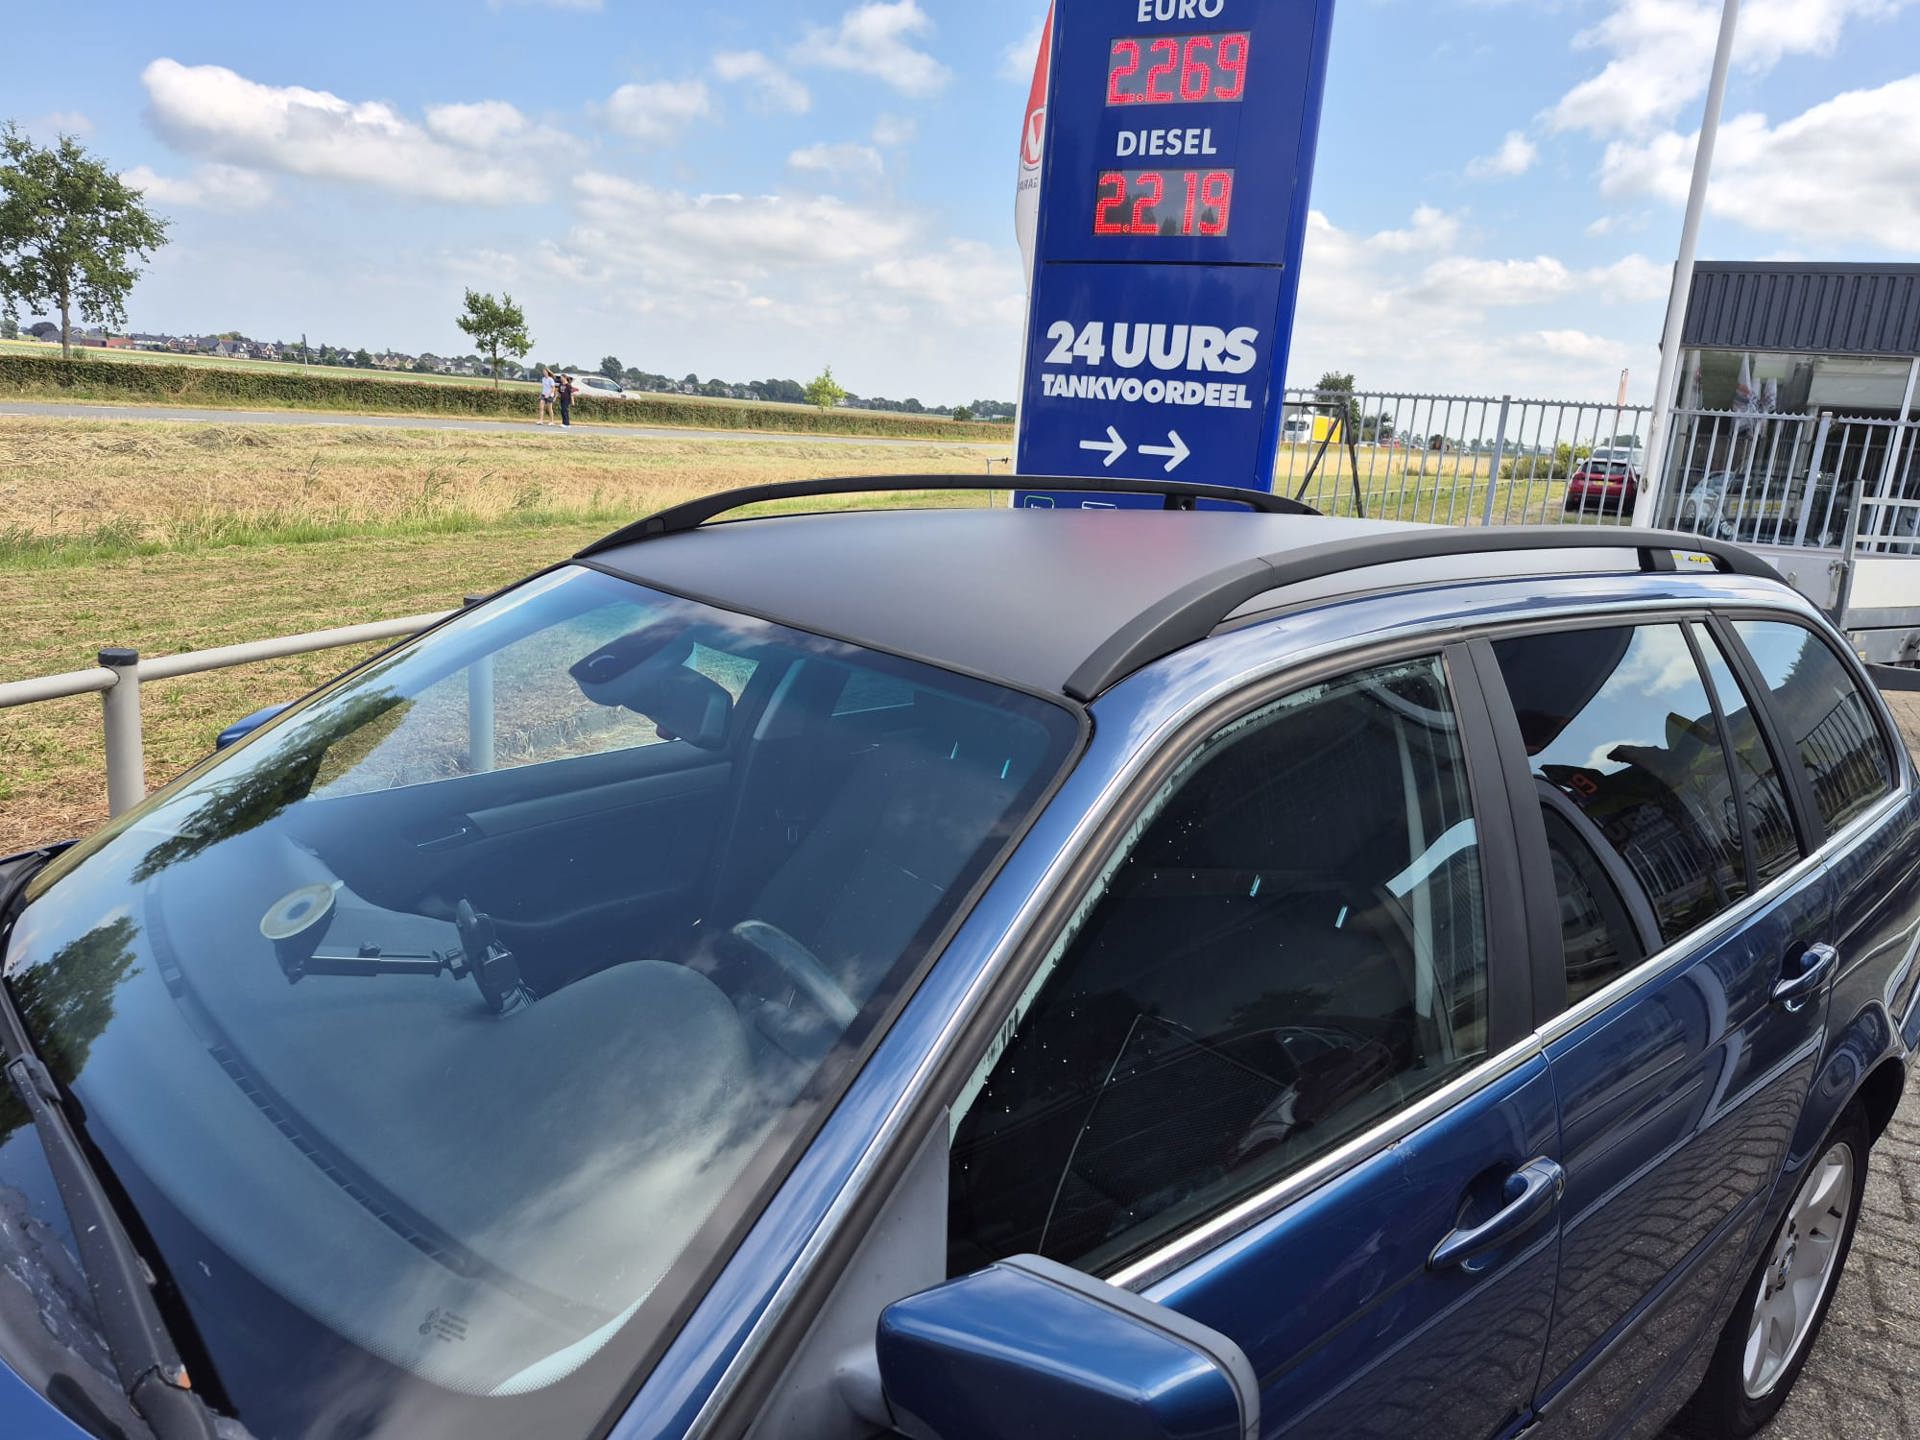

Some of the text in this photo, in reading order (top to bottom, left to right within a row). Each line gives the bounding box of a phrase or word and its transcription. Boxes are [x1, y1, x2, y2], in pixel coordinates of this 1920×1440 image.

[1137, 0, 1225, 22] EURO
[1107, 34, 1249, 104] 2.269
[1116, 128, 1217, 157] DIESEL
[1043, 320, 1259, 374] 24 UURS
[1041, 373, 1252, 409] TANKVOORDEEL
